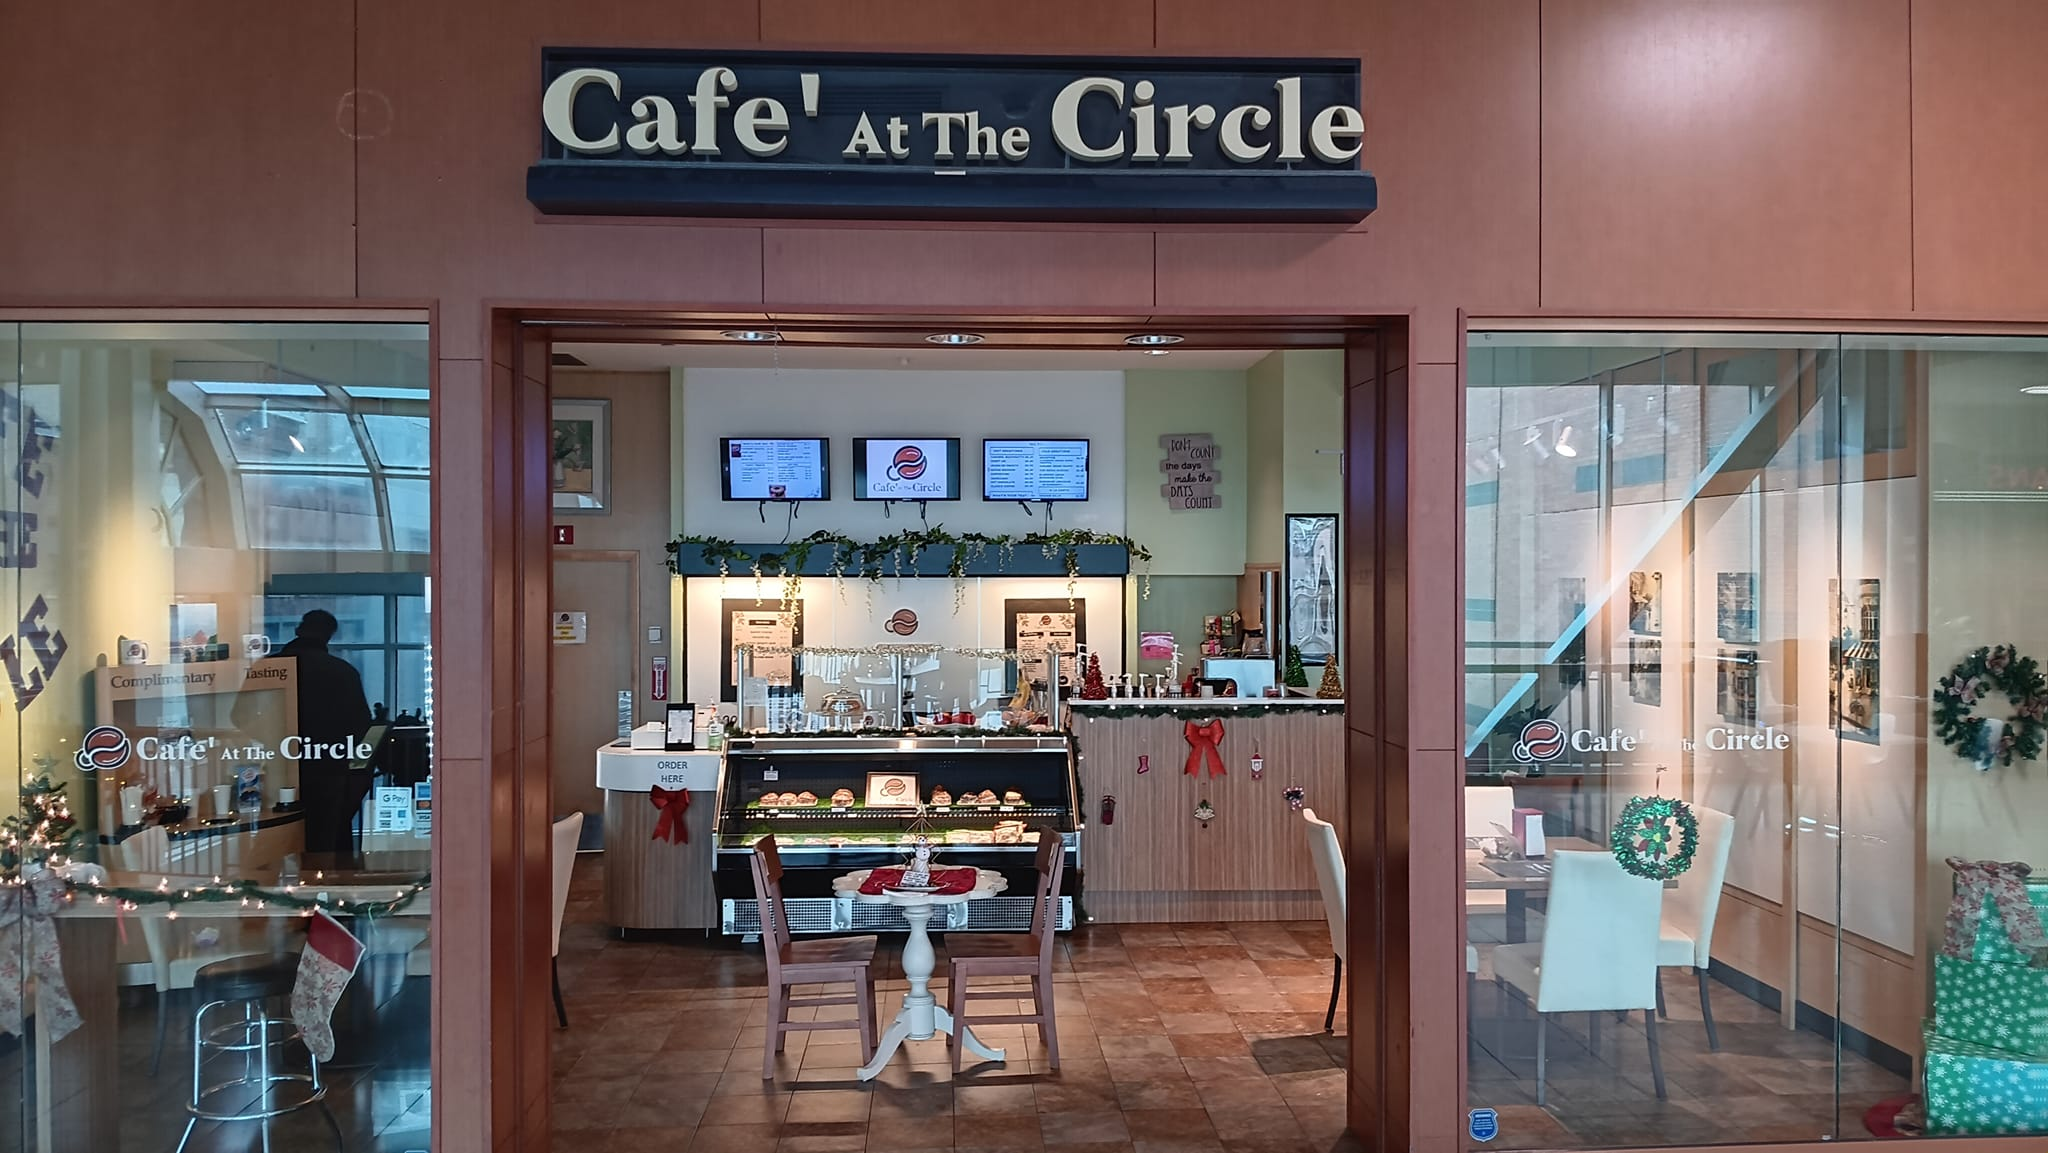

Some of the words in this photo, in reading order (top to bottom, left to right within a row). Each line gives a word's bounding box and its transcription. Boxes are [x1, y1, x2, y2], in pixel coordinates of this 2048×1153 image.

[542, 67, 821, 157] Cafe'
[842, 110, 911, 160] At
[922, 111, 1031, 162] The
[1051, 75, 1364, 163] Circle
[1190, 445, 1214, 459] COUNT
[1181, 462, 1201, 470] days
[1174, 472, 1197, 483] make
[1198, 472, 1213, 483] the
[912, 482, 942, 492] Circle
[1170, 485, 1194, 497] DAYS
[1184, 497, 1212, 509] COUNT
[110, 671, 216, 690] Complimentary
[243, 666, 288, 682] Tasting
[1705, 726, 1790, 751] Circle
[136, 735, 215, 762] Cafe'
[221, 747, 241, 761] At
[243, 746, 275, 761] The
[280, 734, 373, 761] Circle
[657, 761, 688, 769] ORDER
[660, 774, 684, 783] HERE
